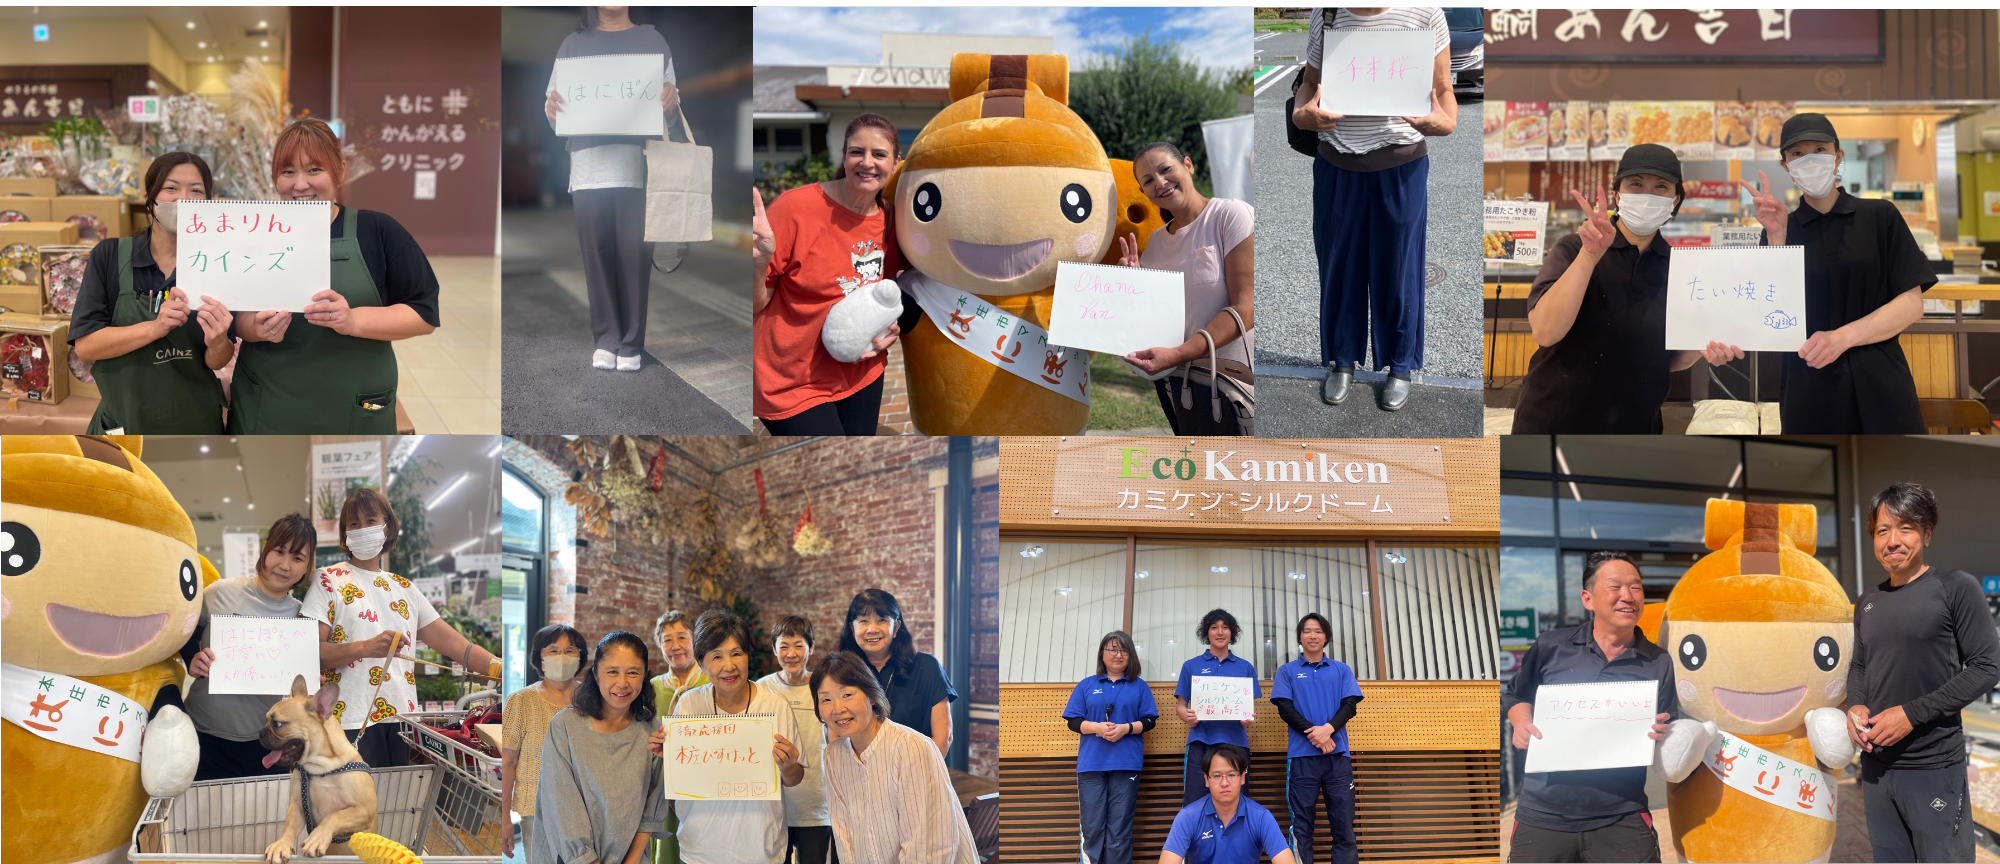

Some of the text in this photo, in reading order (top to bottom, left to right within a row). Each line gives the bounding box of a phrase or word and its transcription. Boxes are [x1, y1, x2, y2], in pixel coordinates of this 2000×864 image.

[870, 52, 951, 86] ohan
[567, 79, 657, 103] はにぽん
[382, 94, 433, 114] ともに
[380, 124, 466, 142] かんがえる
[380, 153, 465, 171] クリニック
[185, 212, 292, 234] あまりん
[188, 246, 294, 273] カインズ
[1074, 271, 1145, 295] Ohana
[1687, 276, 1776, 302] たい焼き
[155, 347, 193, 360] CAINZ
[1200, 682, 1241, 694] カミケン
[1196, 696, 1243, 705] シルクドーム
